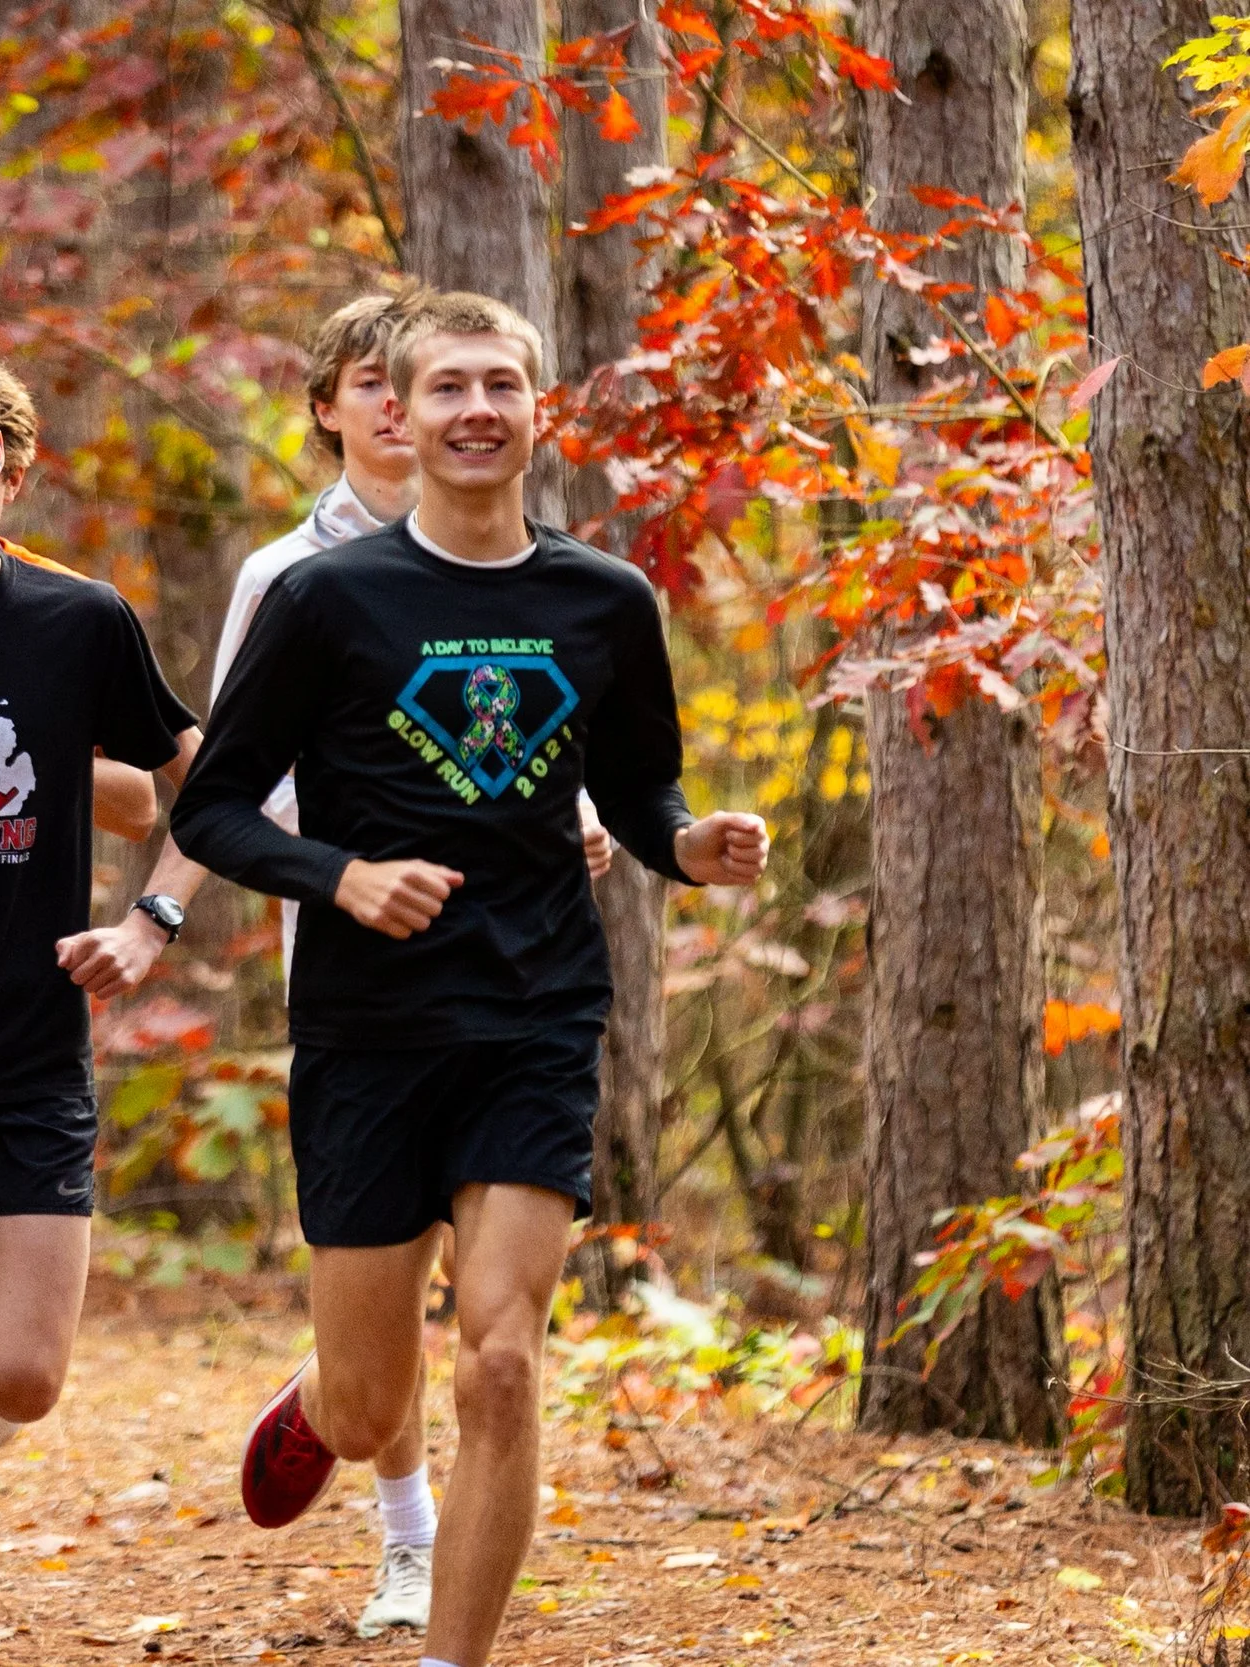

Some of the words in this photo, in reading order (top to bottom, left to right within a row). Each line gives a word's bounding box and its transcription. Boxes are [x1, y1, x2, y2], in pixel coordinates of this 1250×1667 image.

[421, 641, 434, 656] A
[435, 640, 464, 655] DAY
[467, 639, 489, 654] TO
[490, 638, 554, 654] BELIEVE
[386, 710, 444, 764] GLOW
[436, 759, 481, 806] RUN
[515, 724, 573, 799] 2021
